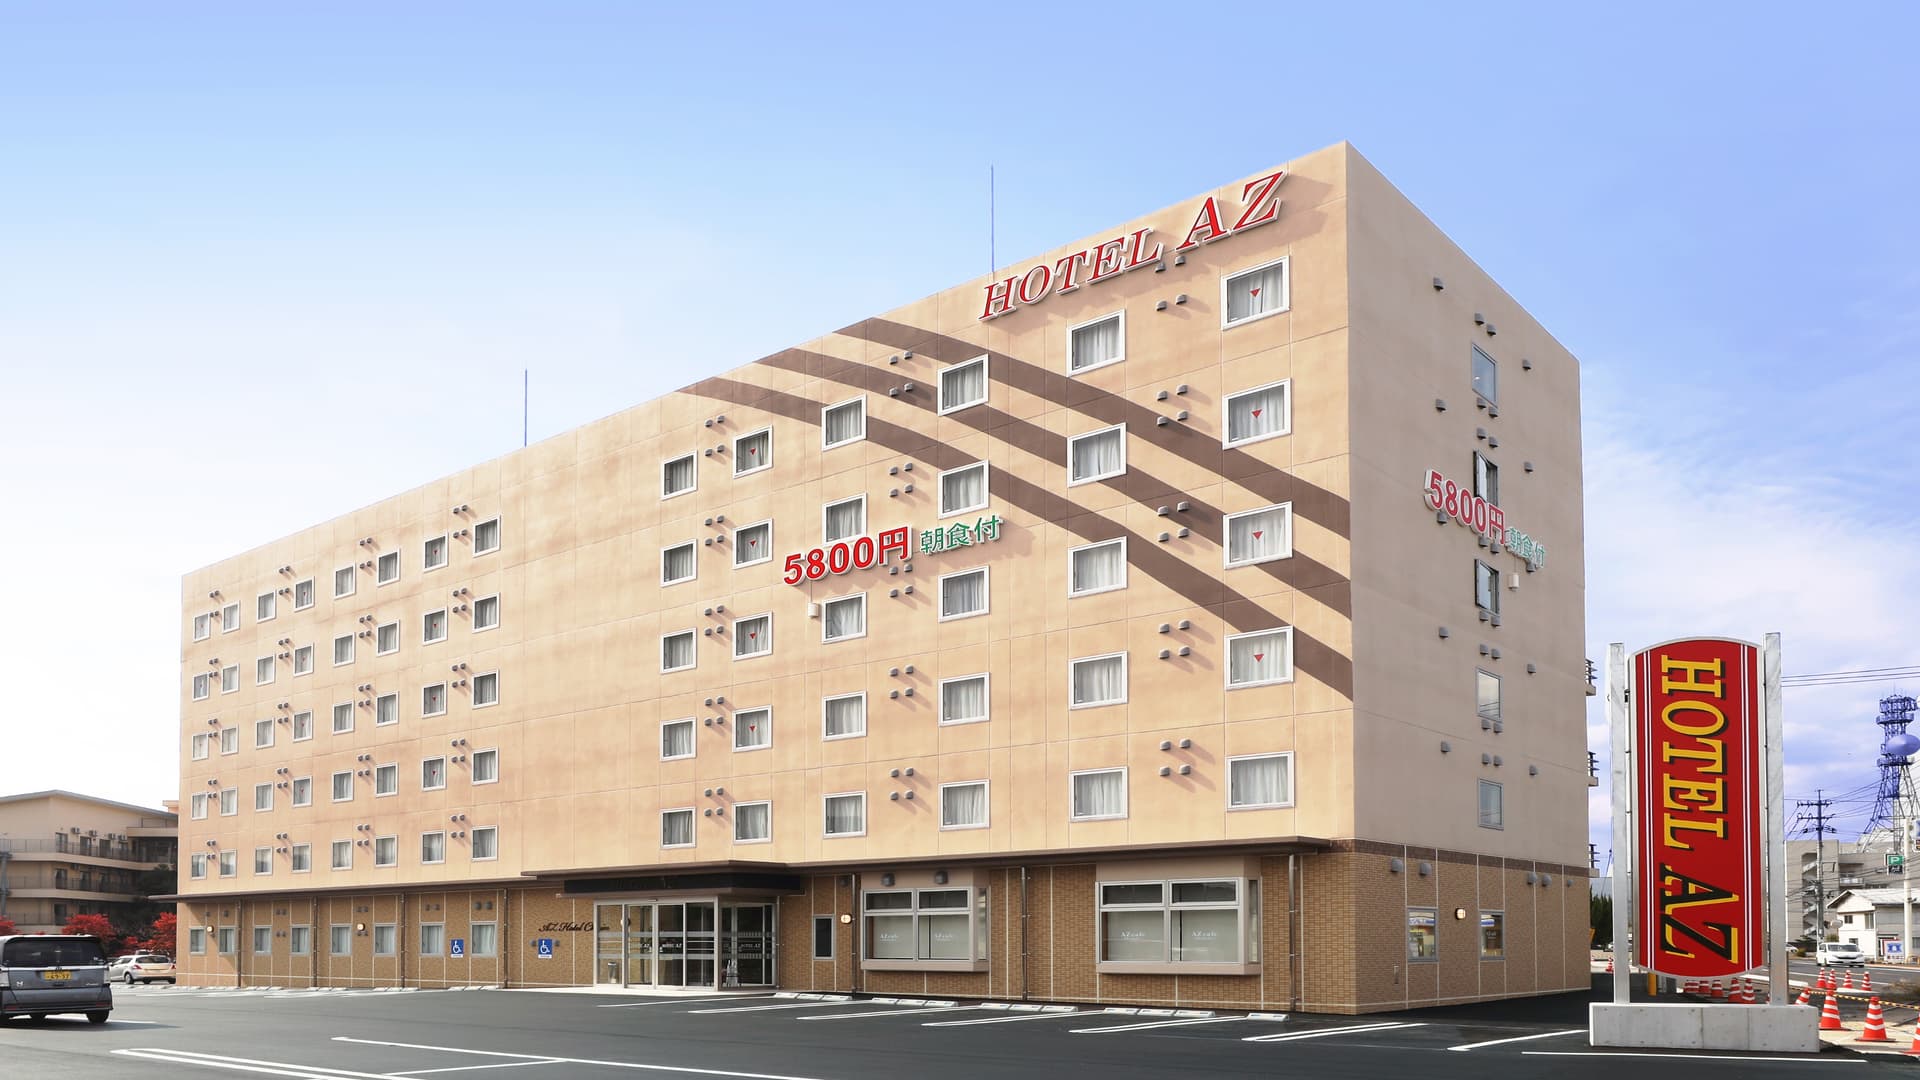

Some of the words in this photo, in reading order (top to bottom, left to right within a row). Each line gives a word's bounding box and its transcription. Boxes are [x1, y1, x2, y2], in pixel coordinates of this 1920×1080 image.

[979, 228, 1164, 320] HOTEL
[1176, 169, 1288, 251] AZ
[784, 526, 912, 585] 5800円
[920, 516, 1003, 553] 朝食付
[1425, 469, 1505, 545] 5800円
[1506, 528, 1545, 568] 朝食付
[1661, 654, 1728, 850] HOTEL
[1660, 863, 1739, 964] AZ
